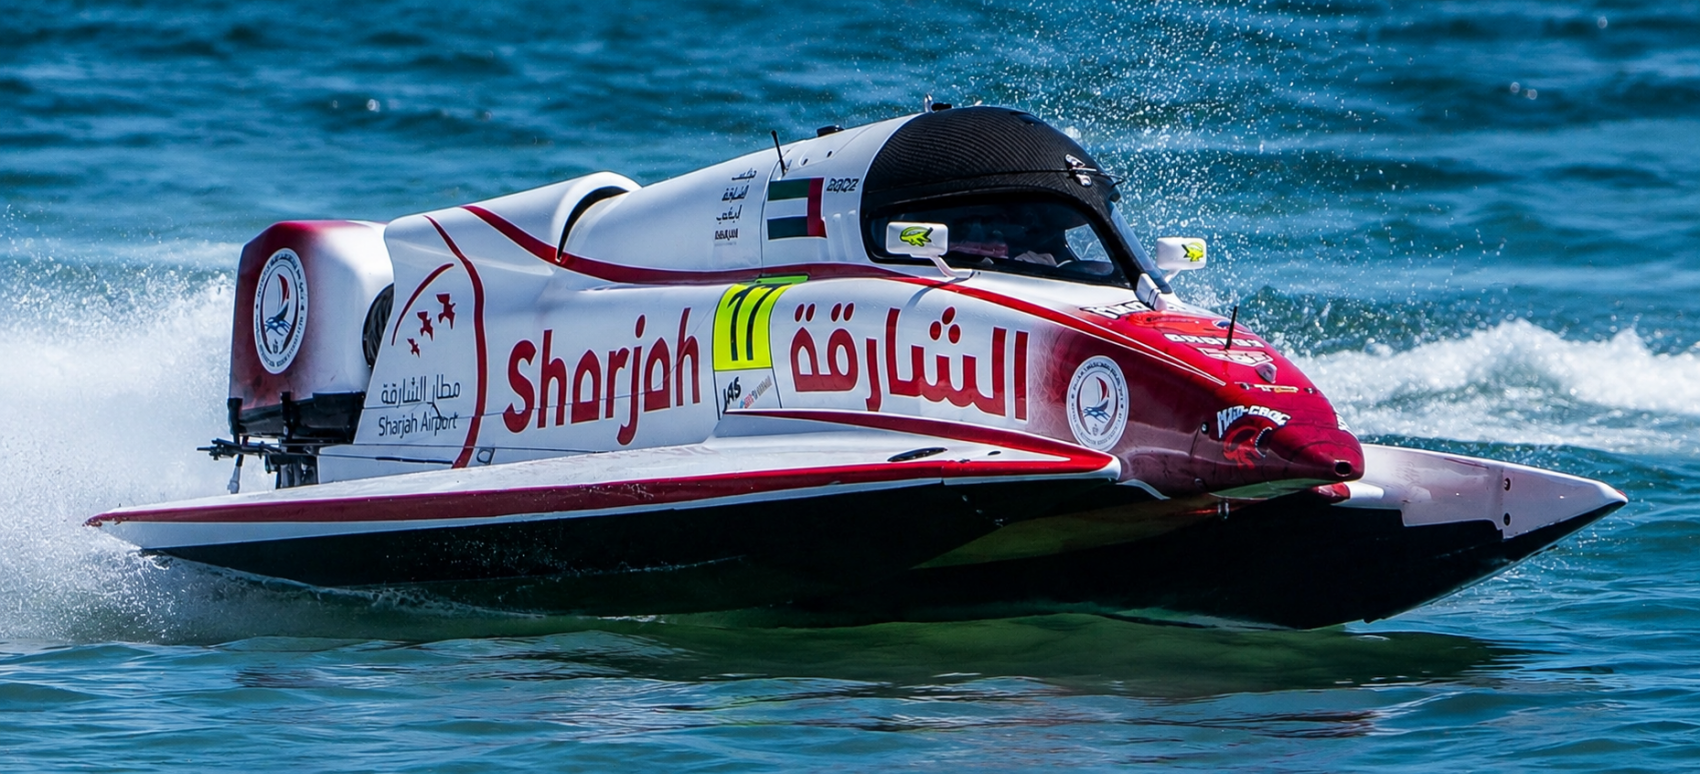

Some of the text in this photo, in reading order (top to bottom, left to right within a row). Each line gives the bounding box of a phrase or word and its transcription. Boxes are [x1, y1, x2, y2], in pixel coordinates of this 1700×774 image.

[381, 374, 461, 409] مطار الشارقة
[502, 306, 701, 446] Sharjah
[789, 302, 1029, 422] الشارقة
[378, 410, 458, 439] Sharjah Airport
